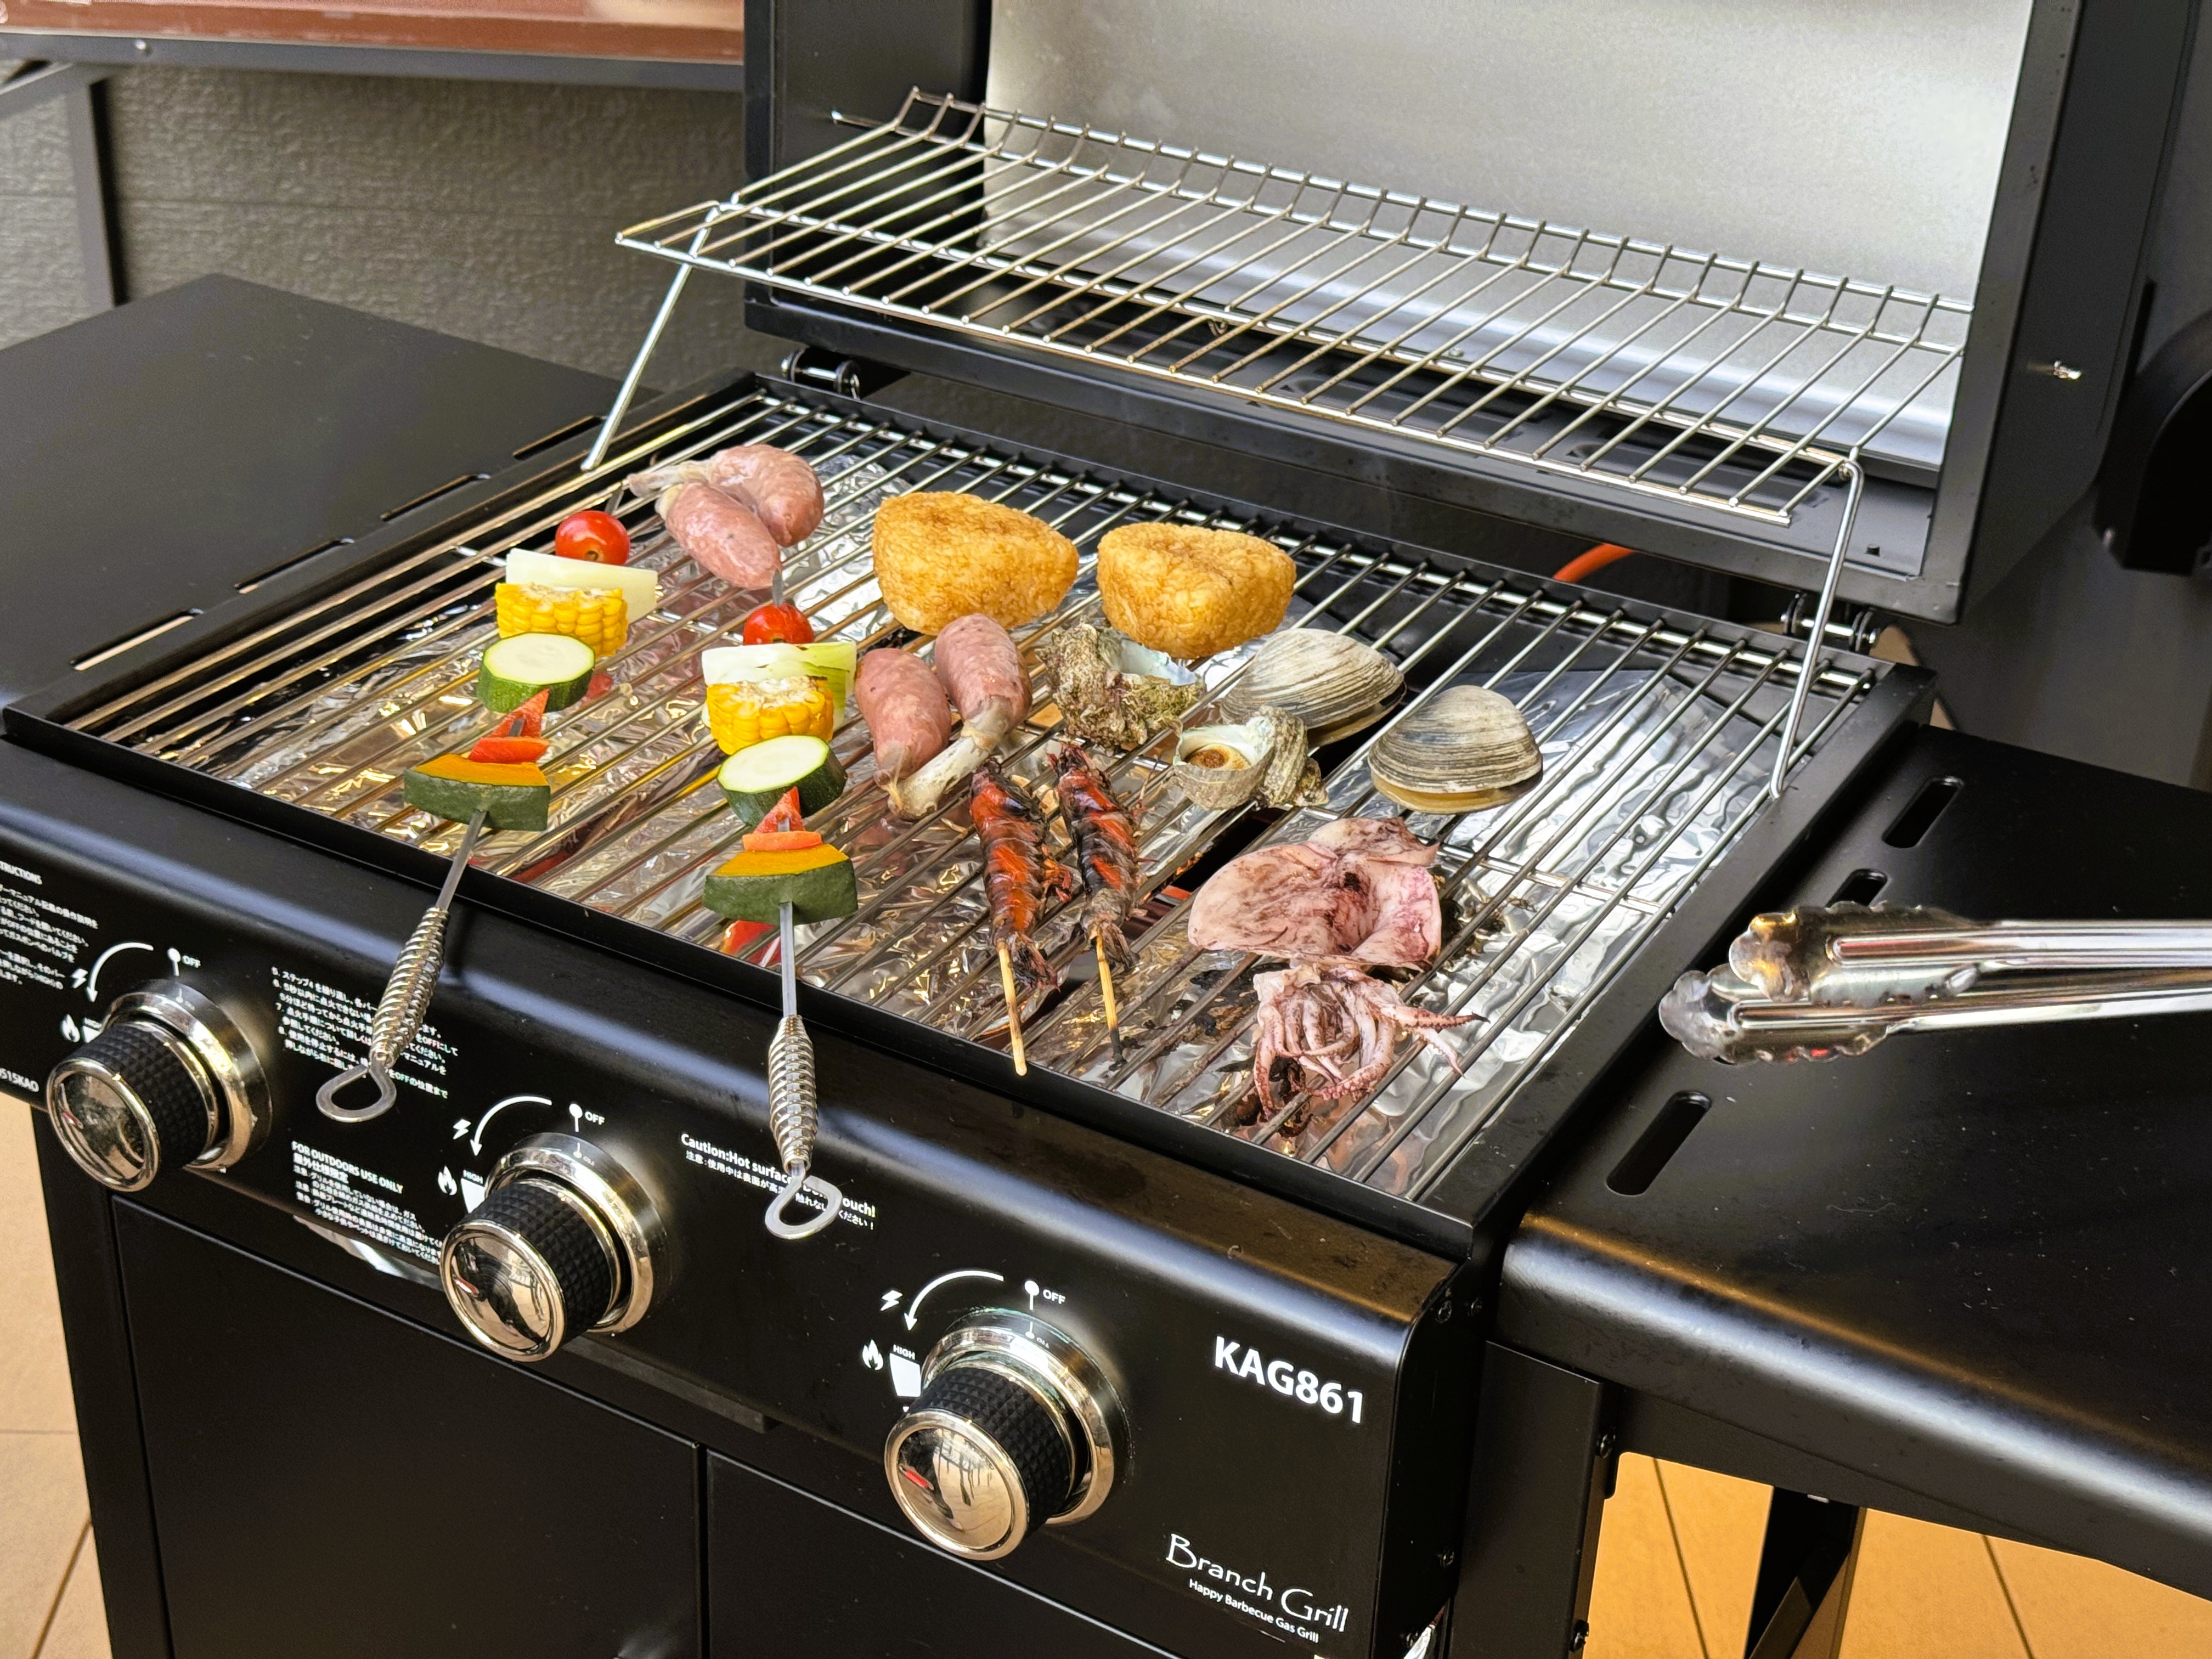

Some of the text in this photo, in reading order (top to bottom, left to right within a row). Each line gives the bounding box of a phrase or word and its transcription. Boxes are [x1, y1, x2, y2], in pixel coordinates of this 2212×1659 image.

[182, 955, 201, 968] OFF
[584, 1111, 605, 1125] OFF
[291, 1141, 404, 1194] FOR OUTDOORS USE ONLY
[462, 1169, 483, 1184] HIGH
[842, 1198, 876, 1218] ouch!
[1042, 1289, 1066, 1305] OFF
[893, 1344, 916, 1360] HIGH
[1215, 1335, 1363, 1424] KAG861
[1165, 1533, 1348, 1632] Branch Grill
[1189, 1578, 1319, 1643] Happy Barbecue Gas Grill
